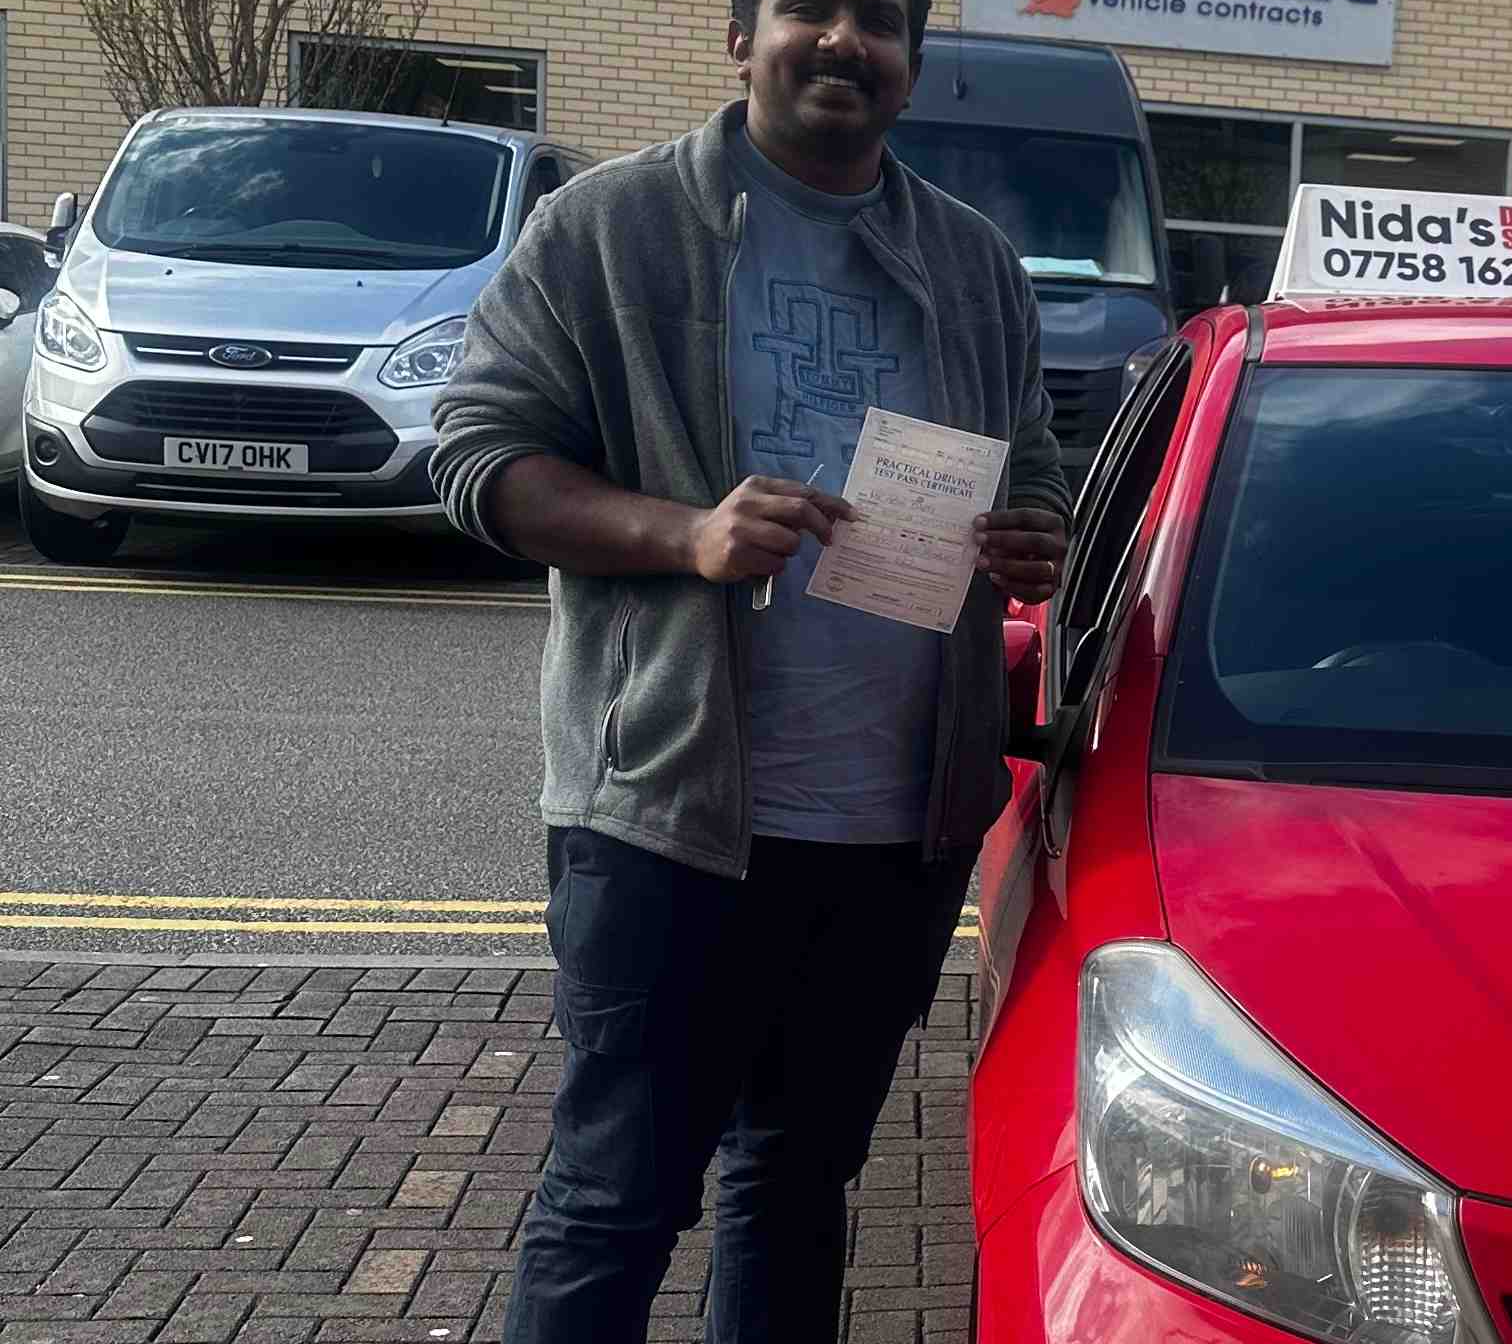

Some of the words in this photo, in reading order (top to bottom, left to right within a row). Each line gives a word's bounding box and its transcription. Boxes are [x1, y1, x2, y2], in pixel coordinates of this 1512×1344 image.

[1197, 0, 1324, 27] contracts
[1320, 197, 1496, 248] Nida's
[1323, 248, 1446, 283] 07758
[178, 441, 234, 466] CV17
[242, 445, 292, 469] OHK
[874, 467, 896, 479] TEST
[920, 479, 974, 499] CERTIFICATE
[876, 457, 931, 478] PRACTICAL
[934, 471, 977, 490] DRIVING
